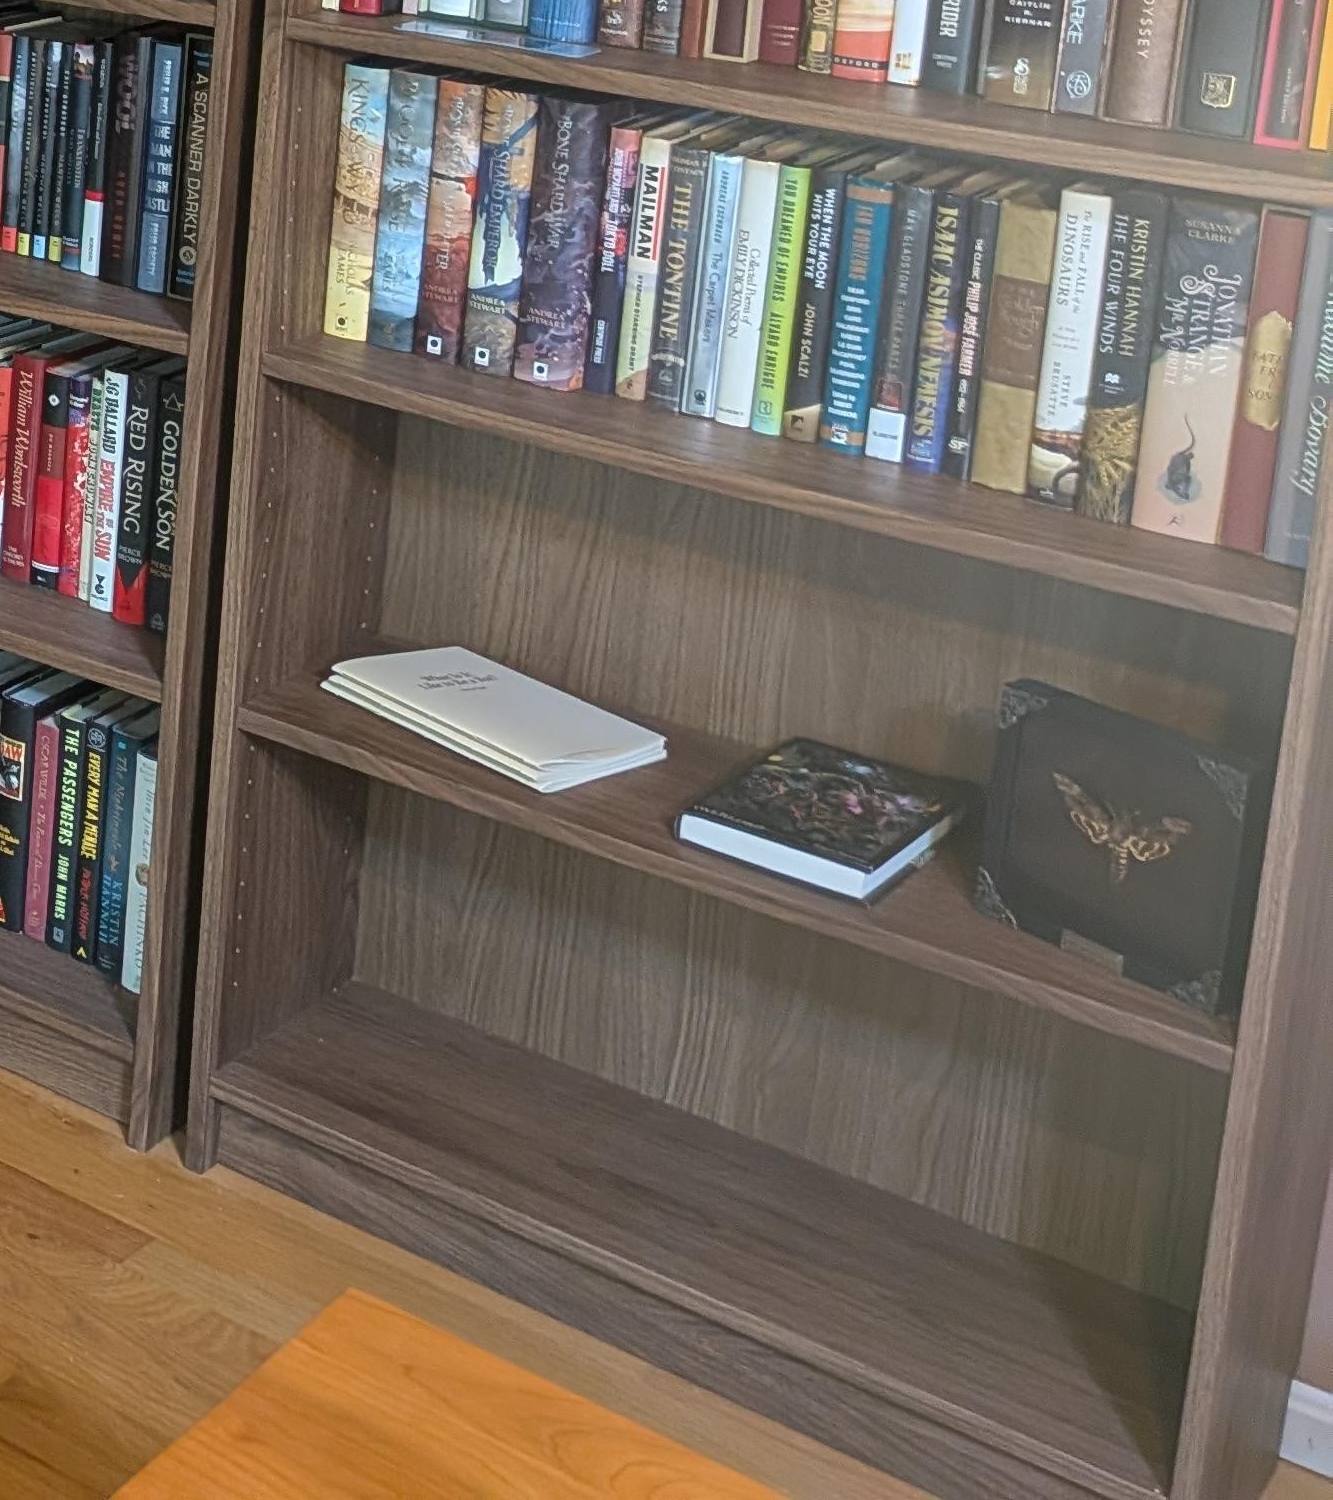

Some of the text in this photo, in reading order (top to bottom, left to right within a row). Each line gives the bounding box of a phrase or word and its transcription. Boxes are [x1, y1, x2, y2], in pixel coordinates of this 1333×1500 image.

[183, 73, 209, 243] A SCANNER DARKLY
[636, 165, 660, 259] MAILMAN
[798, 303, 816, 378] JOHN SCALZI
[1099, 214, 1128, 355] THE FOUR WINDS
[1118, 219, 1150, 357] KRISTIN HANNAH
[122, 405, 148, 534] RED RISING
[155, 420, 180, 551] GOLDEN SON
[58, 729, 80, 847] THE PASSENGERS
[54, 854, 69, 921] JOHN MARRS
